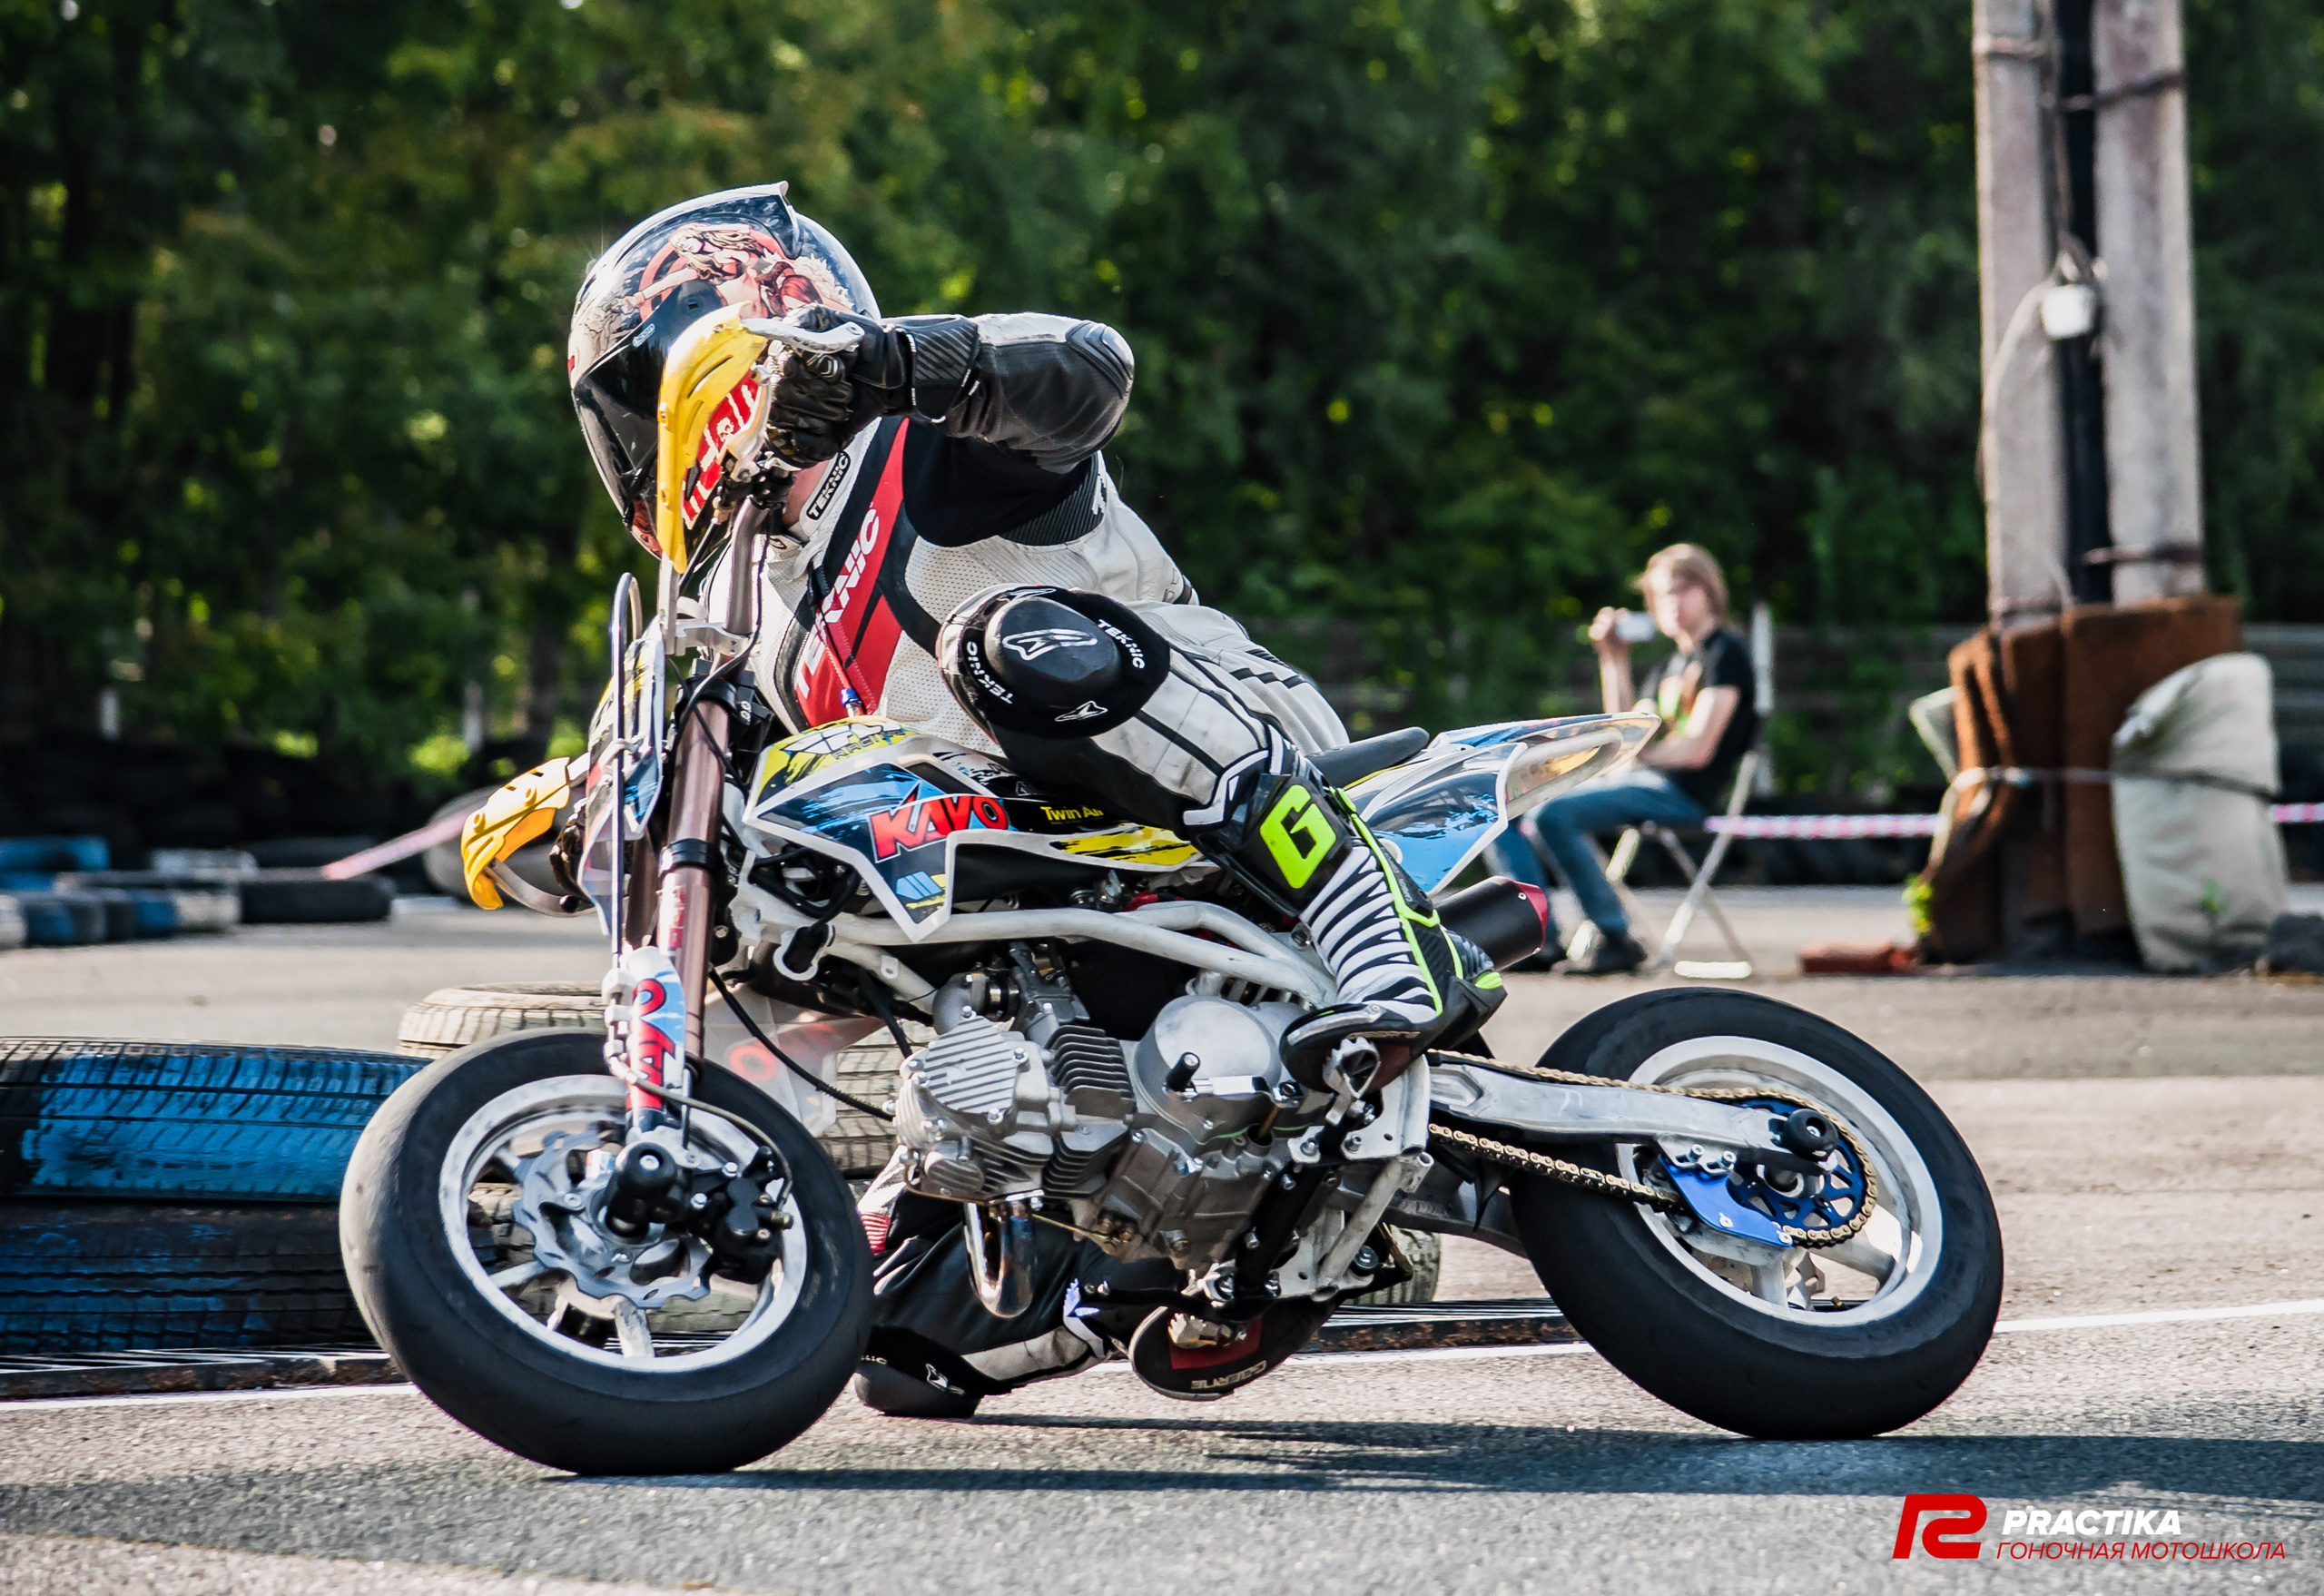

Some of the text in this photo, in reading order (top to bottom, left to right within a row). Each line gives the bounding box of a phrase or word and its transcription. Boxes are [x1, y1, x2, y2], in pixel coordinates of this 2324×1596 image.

[808, 454, 849, 517] TEKNIC
[965, 640, 1015, 704] TEKNIC
[1096, 618, 1147, 670] TEKNIC
[1040, 805, 1082, 821] Twin
